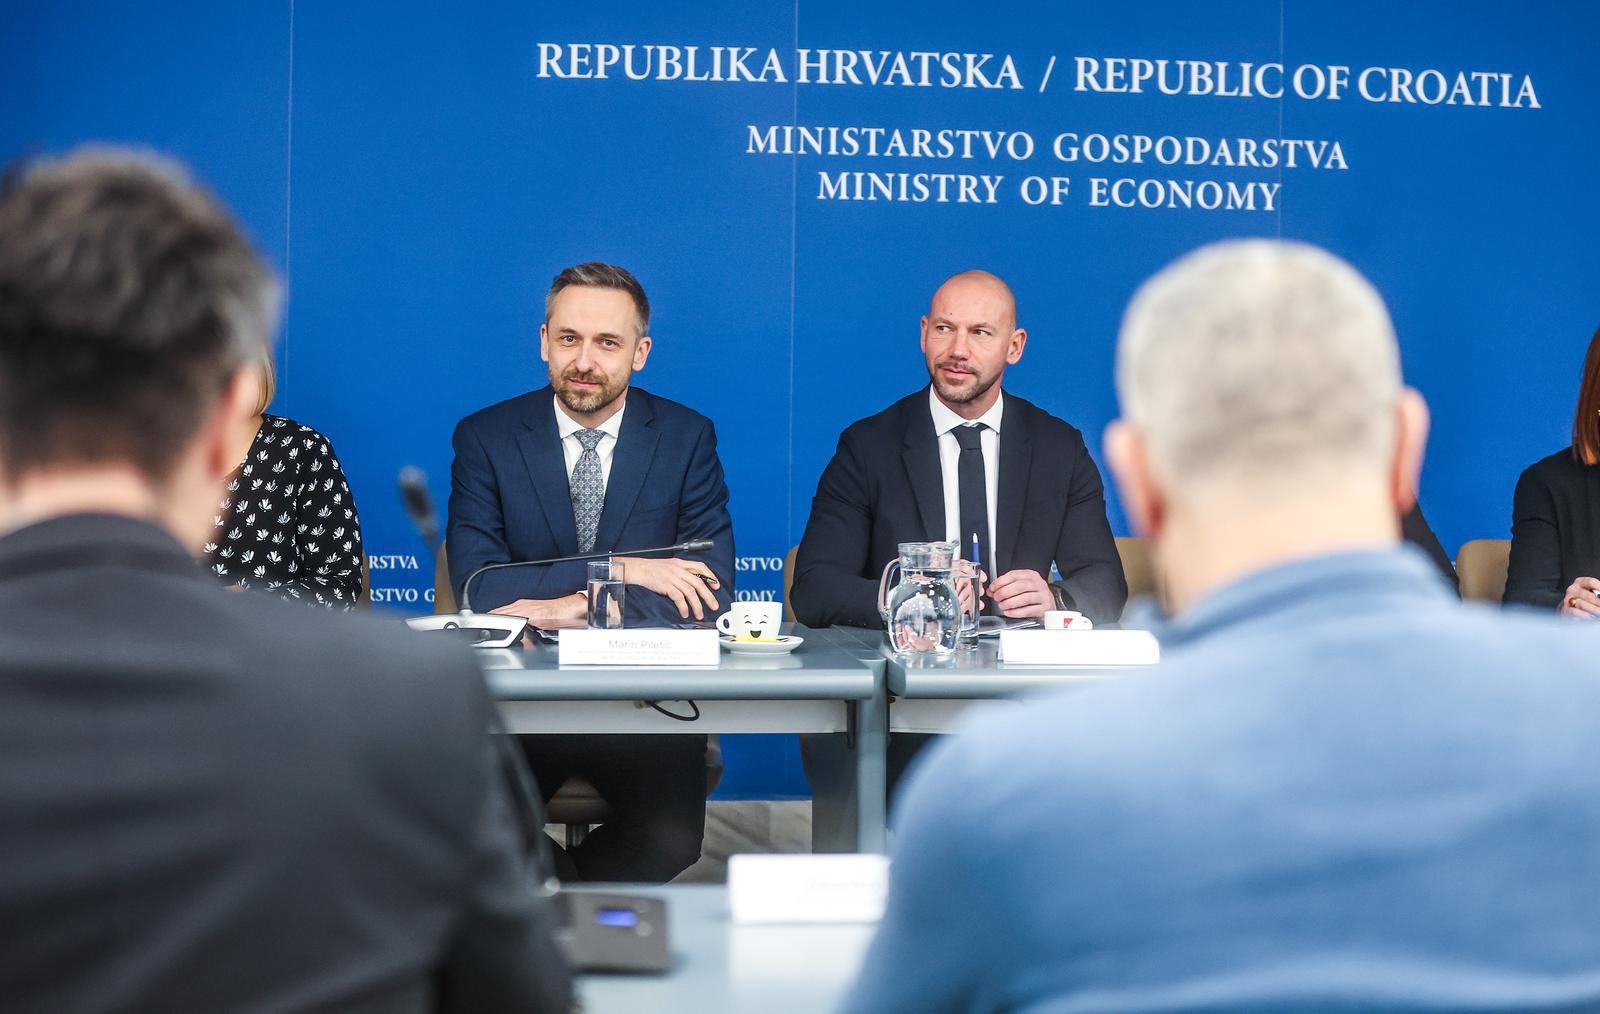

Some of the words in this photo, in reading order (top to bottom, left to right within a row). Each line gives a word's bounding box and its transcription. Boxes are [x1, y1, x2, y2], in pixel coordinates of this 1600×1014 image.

[536, 43, 788, 83] REPUBLIKA
[796, 48, 1024, 90] HRVATSKA
[1039, 55, 1056, 93] /
[1074, 56, 1284, 99] REPUBLIC
[1293, 63, 1350, 100] OF
[1358, 66, 1542, 109] CROATIA
[746, 125, 1035, 161] MINISTARSTVO
[1053, 132, 1349, 170] GOSPODARSTVA
[817, 171, 1004, 204] MINISTRY
[1020, 175, 1070, 206] OF
[1089, 177, 1281, 212] ECONOMY
